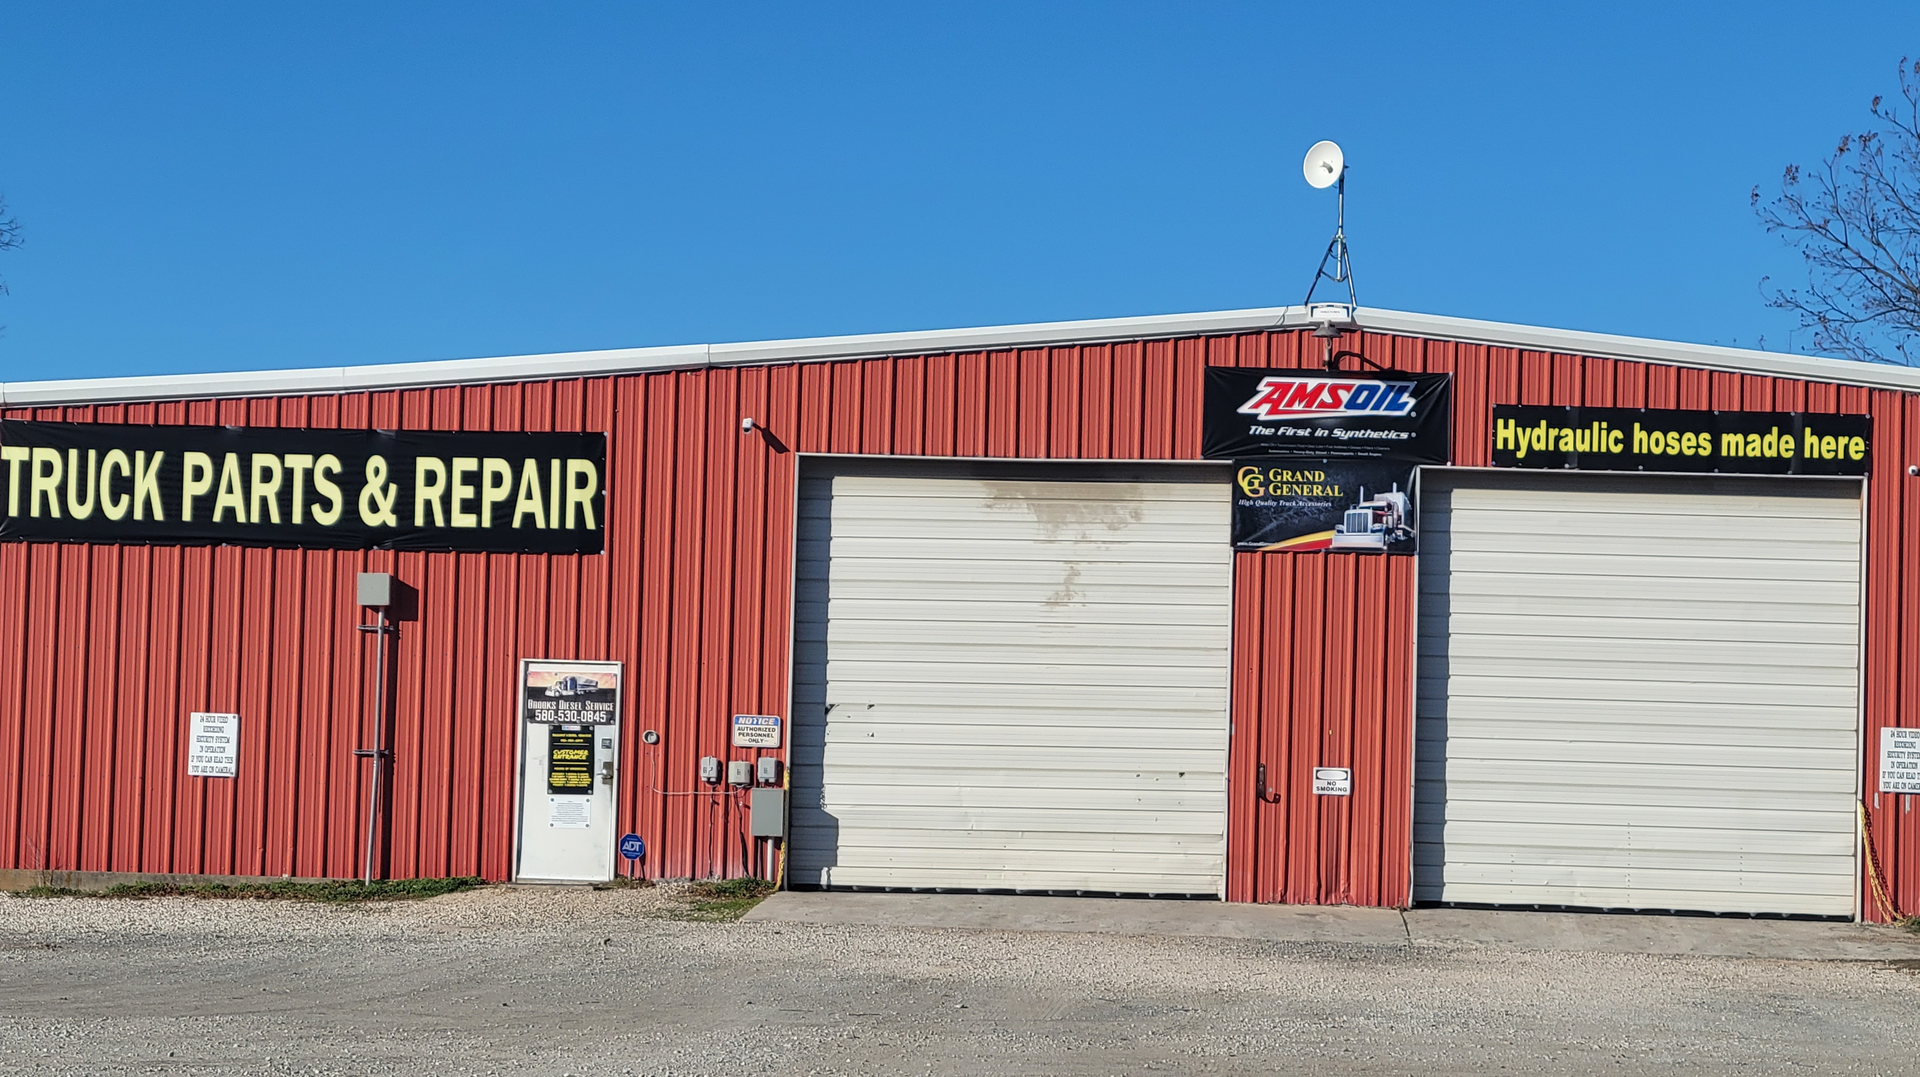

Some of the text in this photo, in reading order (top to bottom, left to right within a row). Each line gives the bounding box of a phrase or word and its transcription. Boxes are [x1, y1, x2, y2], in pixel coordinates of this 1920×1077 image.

[1243, 379, 1416, 418] AMSOIL
[1249, 425, 1409, 440] The First in Synthetics
[1496, 418, 1865, 460] Hydraulic hoses made here
[1268, 468, 1325, 482] GRAND
[1, 446, 598, 530] TRUCK PARTS & REPAIR
[1268, 482, 1344, 497] GENERAL
[1238, 499, 1254, 508] High
[1255, 499, 1277, 508] Quality
[1297, 500, 1332, 508] Accessories
[527, 699, 614, 711] BROOKS DIESEL SERVICE
[200, 715, 229, 724] 24 HOUR VIDEO
[535, 710, 607, 722] 580-530-0845
[738, 717, 776, 725] NOTICE
[196, 735, 231, 743] SECURITY SYSTEM
[1890, 730, 1895, 738] 24
[1896, 731, 1907, 739] HOUR
[199, 745, 226, 753] IN OPERATION
[1894, 740, 1916, 749] RECORDING
[1887, 750, 1920, 759] SECURITY SYSTE
[196, 755, 204, 763] YOU
[205, 755, 213, 763] CAN
[213, 756, 224, 764] READ
[191, 765, 200, 773] YOU
[200, 765, 208, 773] ARE
[209, 765, 215, 773] ON
[1890, 761, 1918, 769] IN OPERATION
[1882, 771, 1886, 779] IF
[1887, 771, 1895, 779] YOU
[1896, 771, 1905, 779] CAN
[1905, 772, 1916, 780] READ
[1883, 781, 1891, 789] YOU
[1892, 782, 1900, 790] ARE
[1901, 782, 1907, 790] ON
[622, 841, 642, 852] ADT
